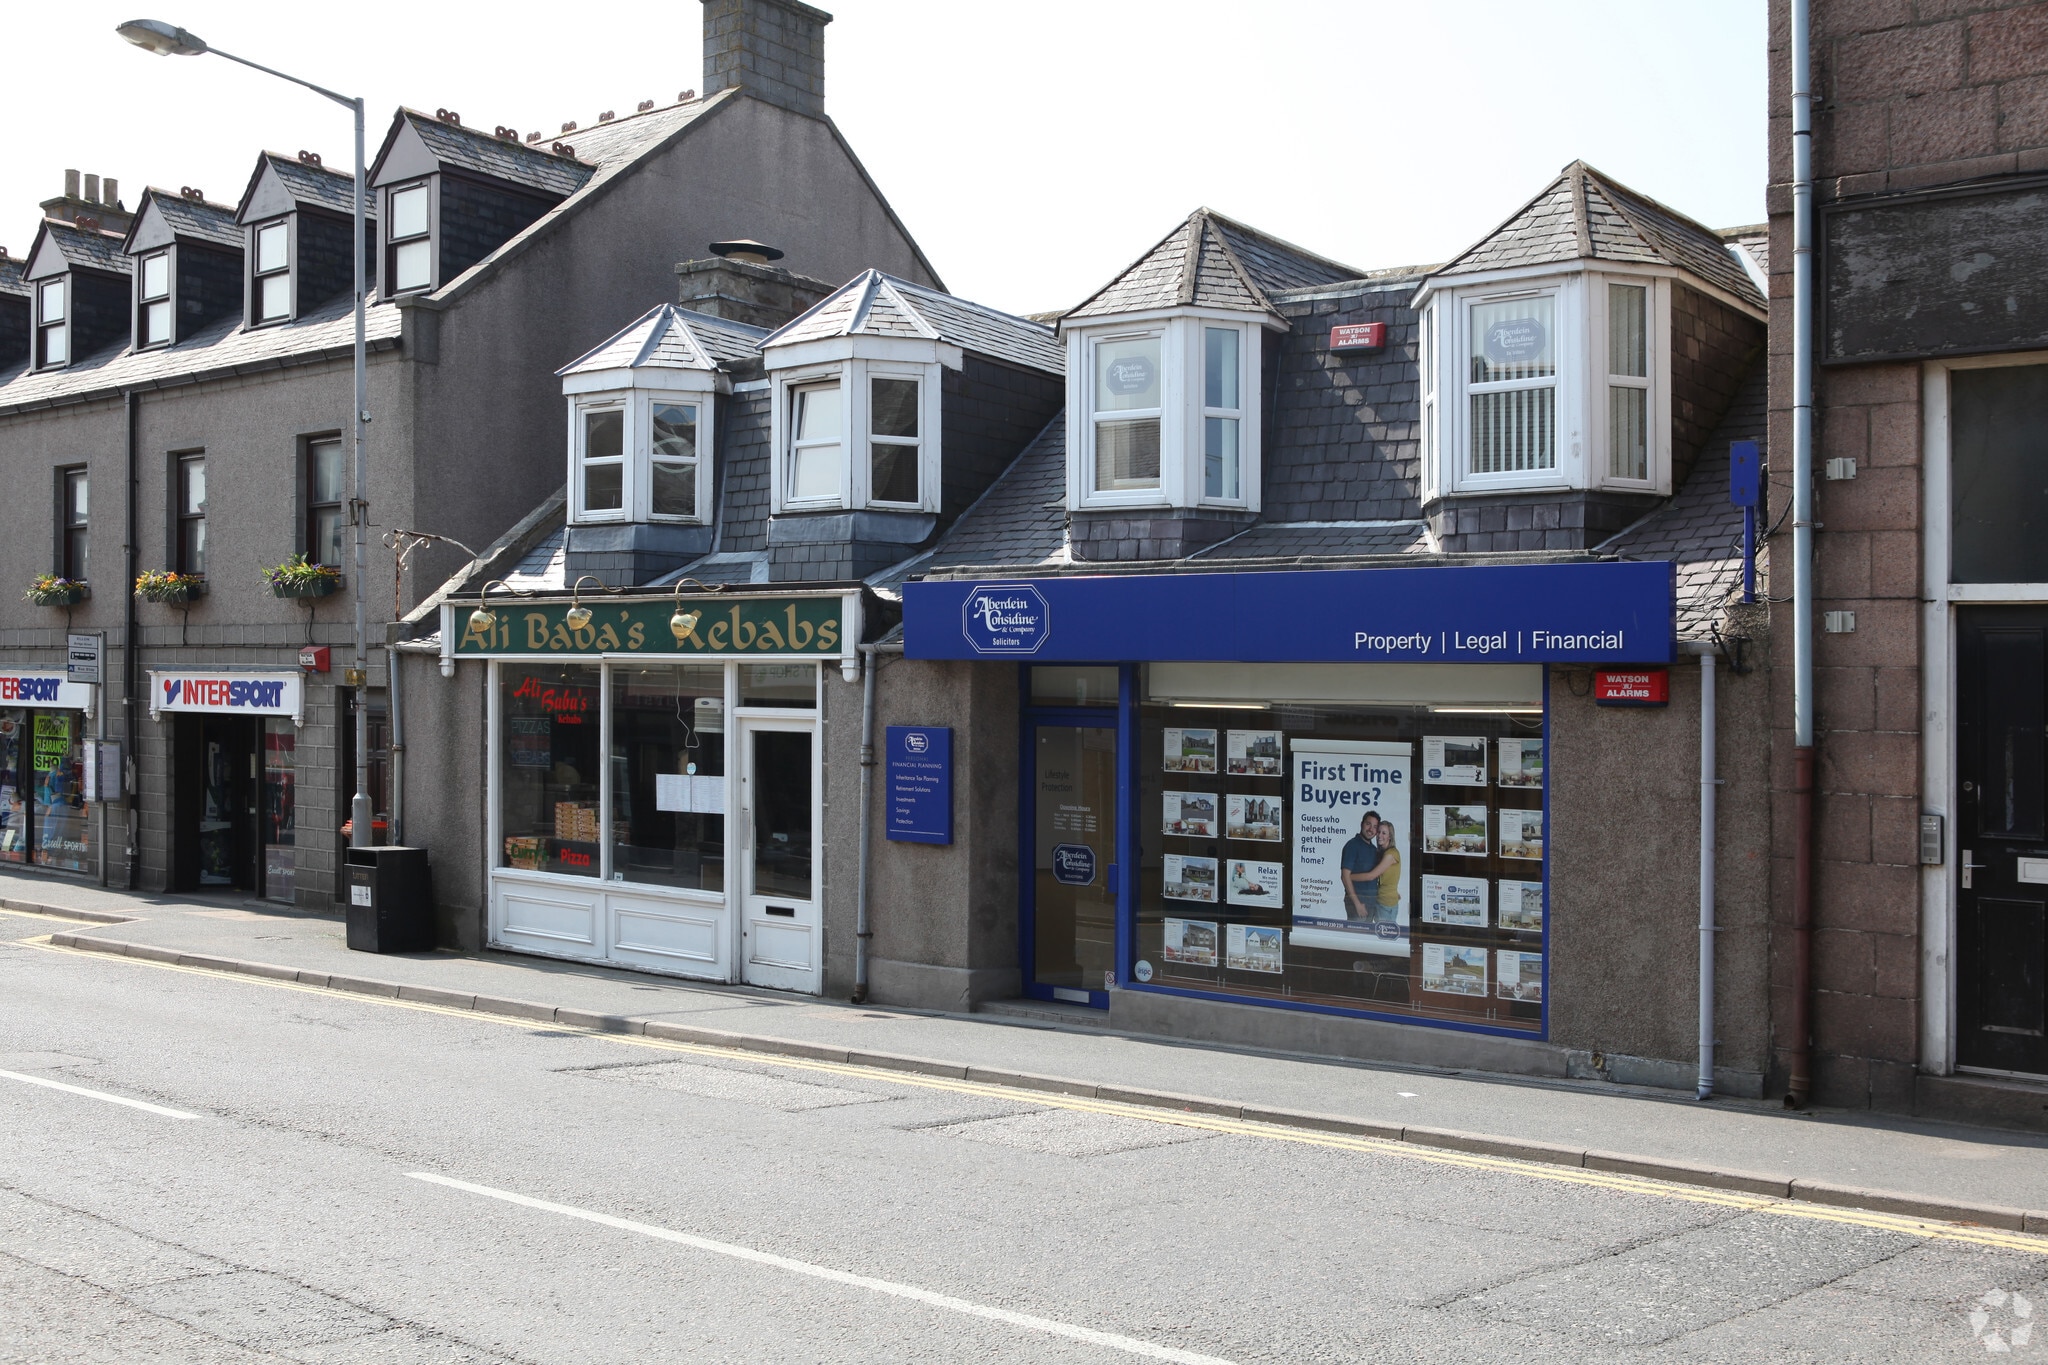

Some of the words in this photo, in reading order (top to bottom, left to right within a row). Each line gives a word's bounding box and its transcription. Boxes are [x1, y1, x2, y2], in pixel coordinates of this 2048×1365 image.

[1340, 327, 1370, 335] WATSON
[1338, 338, 1369, 346] ALARMS
[973, 596, 1028, 618] Aberdein
[986, 609, 1038, 632] Considine
[458, 610, 510, 649] Ali
[523, 610, 645, 650] Baba's
[677, 603, 839, 650] Kebabs
[1009, 627, 1036, 635] Company
[992, 638, 1020, 646] Solicitors
[1355, 632, 1432, 653] Property
[1455, 631, 1507, 653] Legal
[1532, 631, 1623, 649] Financial
[1606, 675, 1649, 683] WATSON
[513, 677, 541, 698] Ali
[183, 680, 284, 707] INTERSPORT
[541, 688, 587, 712] Baba's
[512, 720, 550, 734] PIZZAS
[36, 756, 60, 768] SHO
[1045, 769, 1070, 780] Lifestyle
[1301, 761, 1345, 781] First
[1350, 763, 1402, 784] Time
[1042, 782, 1072, 792] Protection
[1301, 784, 1381, 809] Buyers?
[1301, 814, 1322, 823] Guess
[1324, 815, 1340, 823] who
[1301, 824, 1326, 834] helped
[1327, 826, 1346, 834] them
[1301, 836, 1313, 844] get
[1314, 836, 1332, 844] their
[1301, 845, 1315, 853] first
[561, 848, 590, 866] Pizza
[1301, 856, 1325, 864] home?
[1258, 866, 1278, 875] Relax
[1457, 887, 1478, 895] Property
